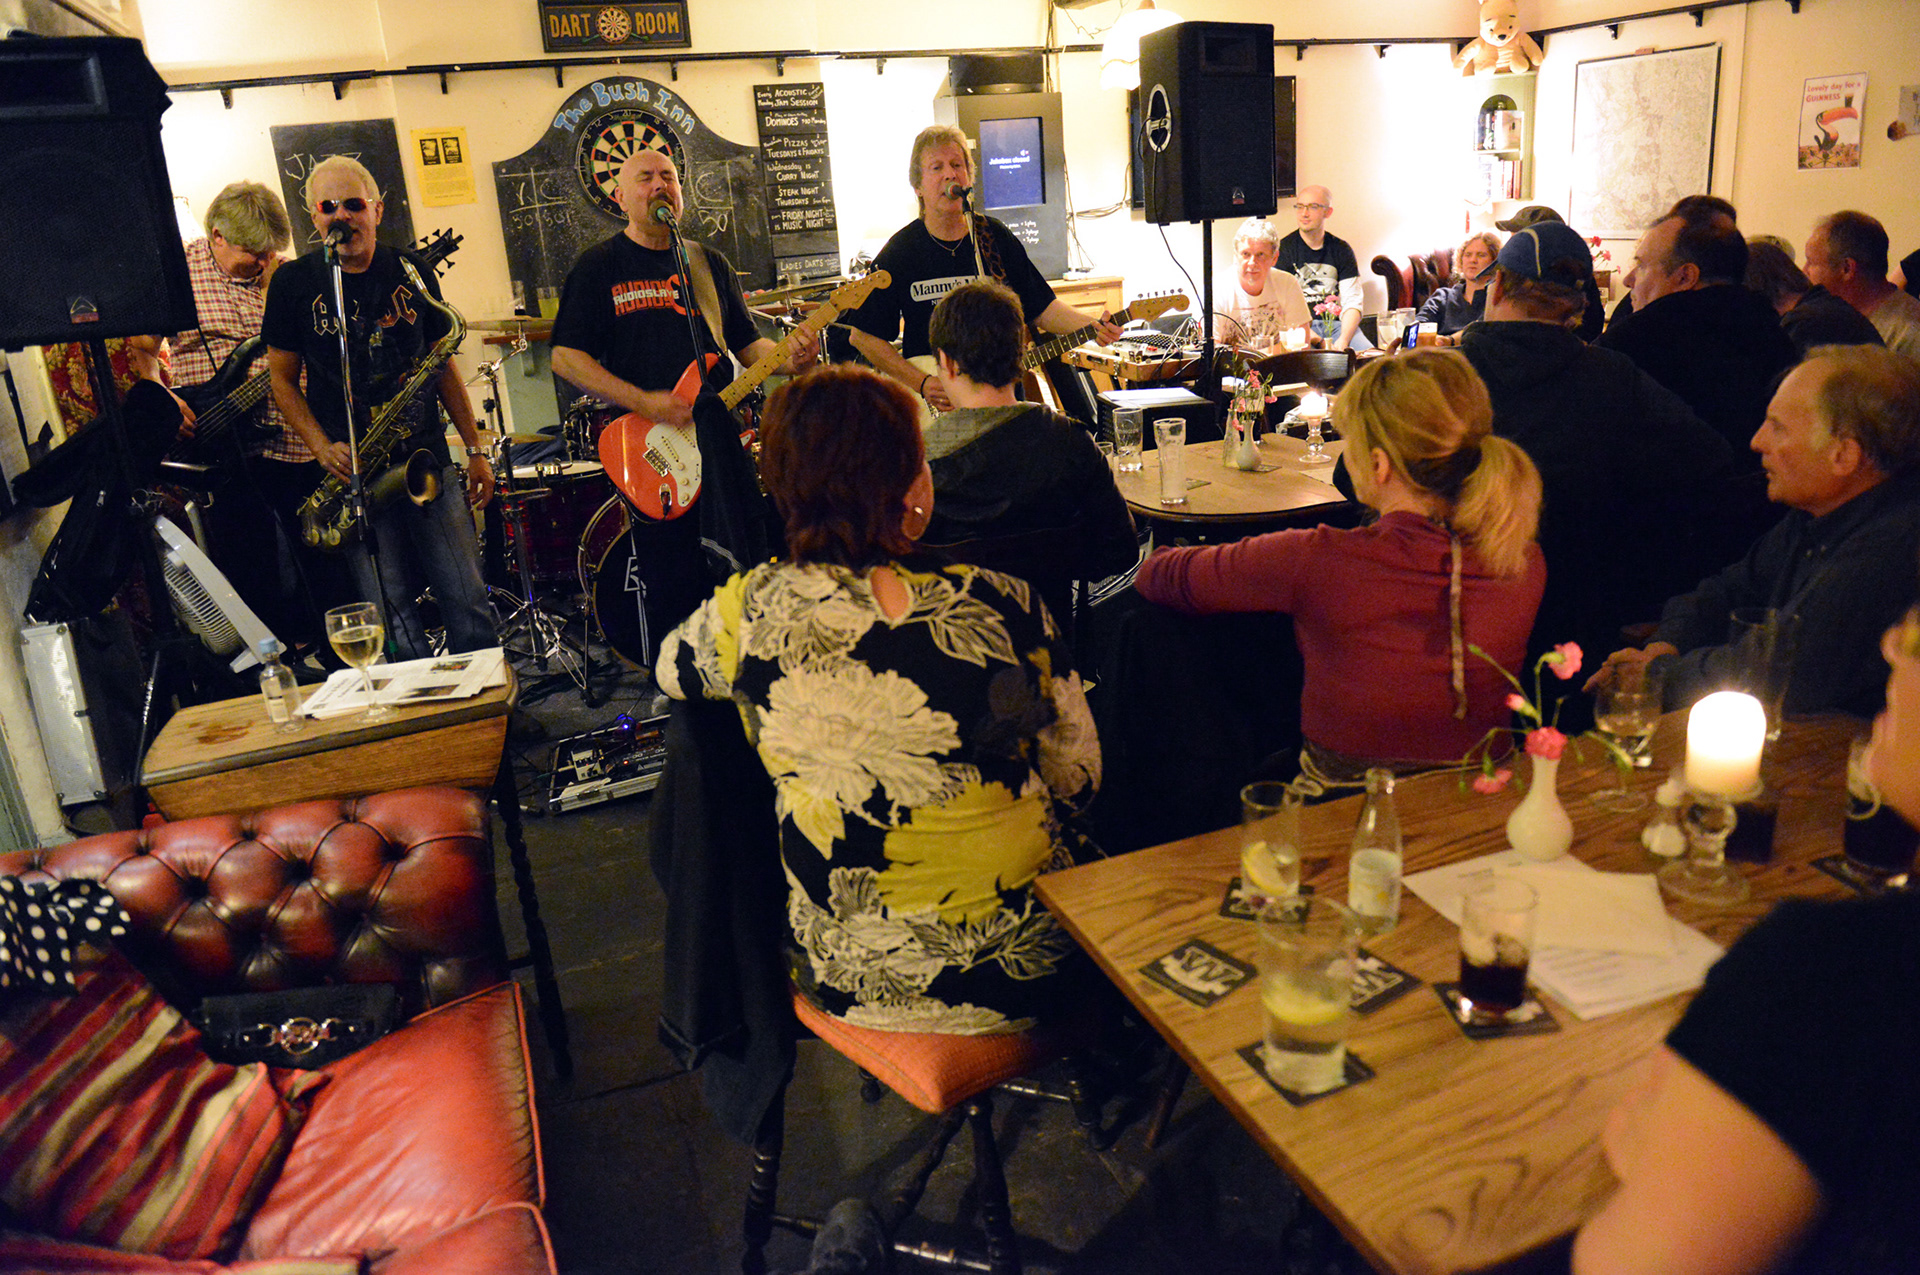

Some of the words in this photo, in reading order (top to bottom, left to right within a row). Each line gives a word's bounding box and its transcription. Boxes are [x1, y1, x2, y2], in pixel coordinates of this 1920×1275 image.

[550, 13, 591, 38] DART
[635, 11, 680, 35] ROOM
[1807, 84, 1829, 93] Lovely
[1830, 83, 1843, 91] day
[1845, 81, 1855, 89] for
[774, 88, 808, 98] ACOUSTIC
[1806, 93, 1841, 103] GUINNESS
[774, 98, 789, 107] JAM
[790, 96, 819, 107] SESSION
[553, 98, 593, 133] The
[591, 81, 650, 107] Bush
[653, 88, 696, 135] Inn
[765, 116, 799, 127] DOMINOES
[783, 137, 808, 148] PIZZAS
[766, 148, 797, 158] TUESDAYS
[802, 147, 824, 157] FRIDAYS
[766, 163, 803, 172] Wednesday
[776, 171, 798, 181] CURRY
[800, 170, 820, 180] NIGHT
[778, 188, 800, 197] STEAK
[800, 186, 819, 196] NIGHT
[775, 197, 809, 207] THURSDAYS
[781, 210, 805, 221] FRIDAY
[805, 208, 824, 219] NIGHT
[782, 220, 803, 231] MUSIC
[805, 217, 824, 229] NIGHT
[780, 261, 803, 272] LADIES
[804, 258, 824, 269] DARTS
[613, 288, 680, 306] AUDIOSLAVE
